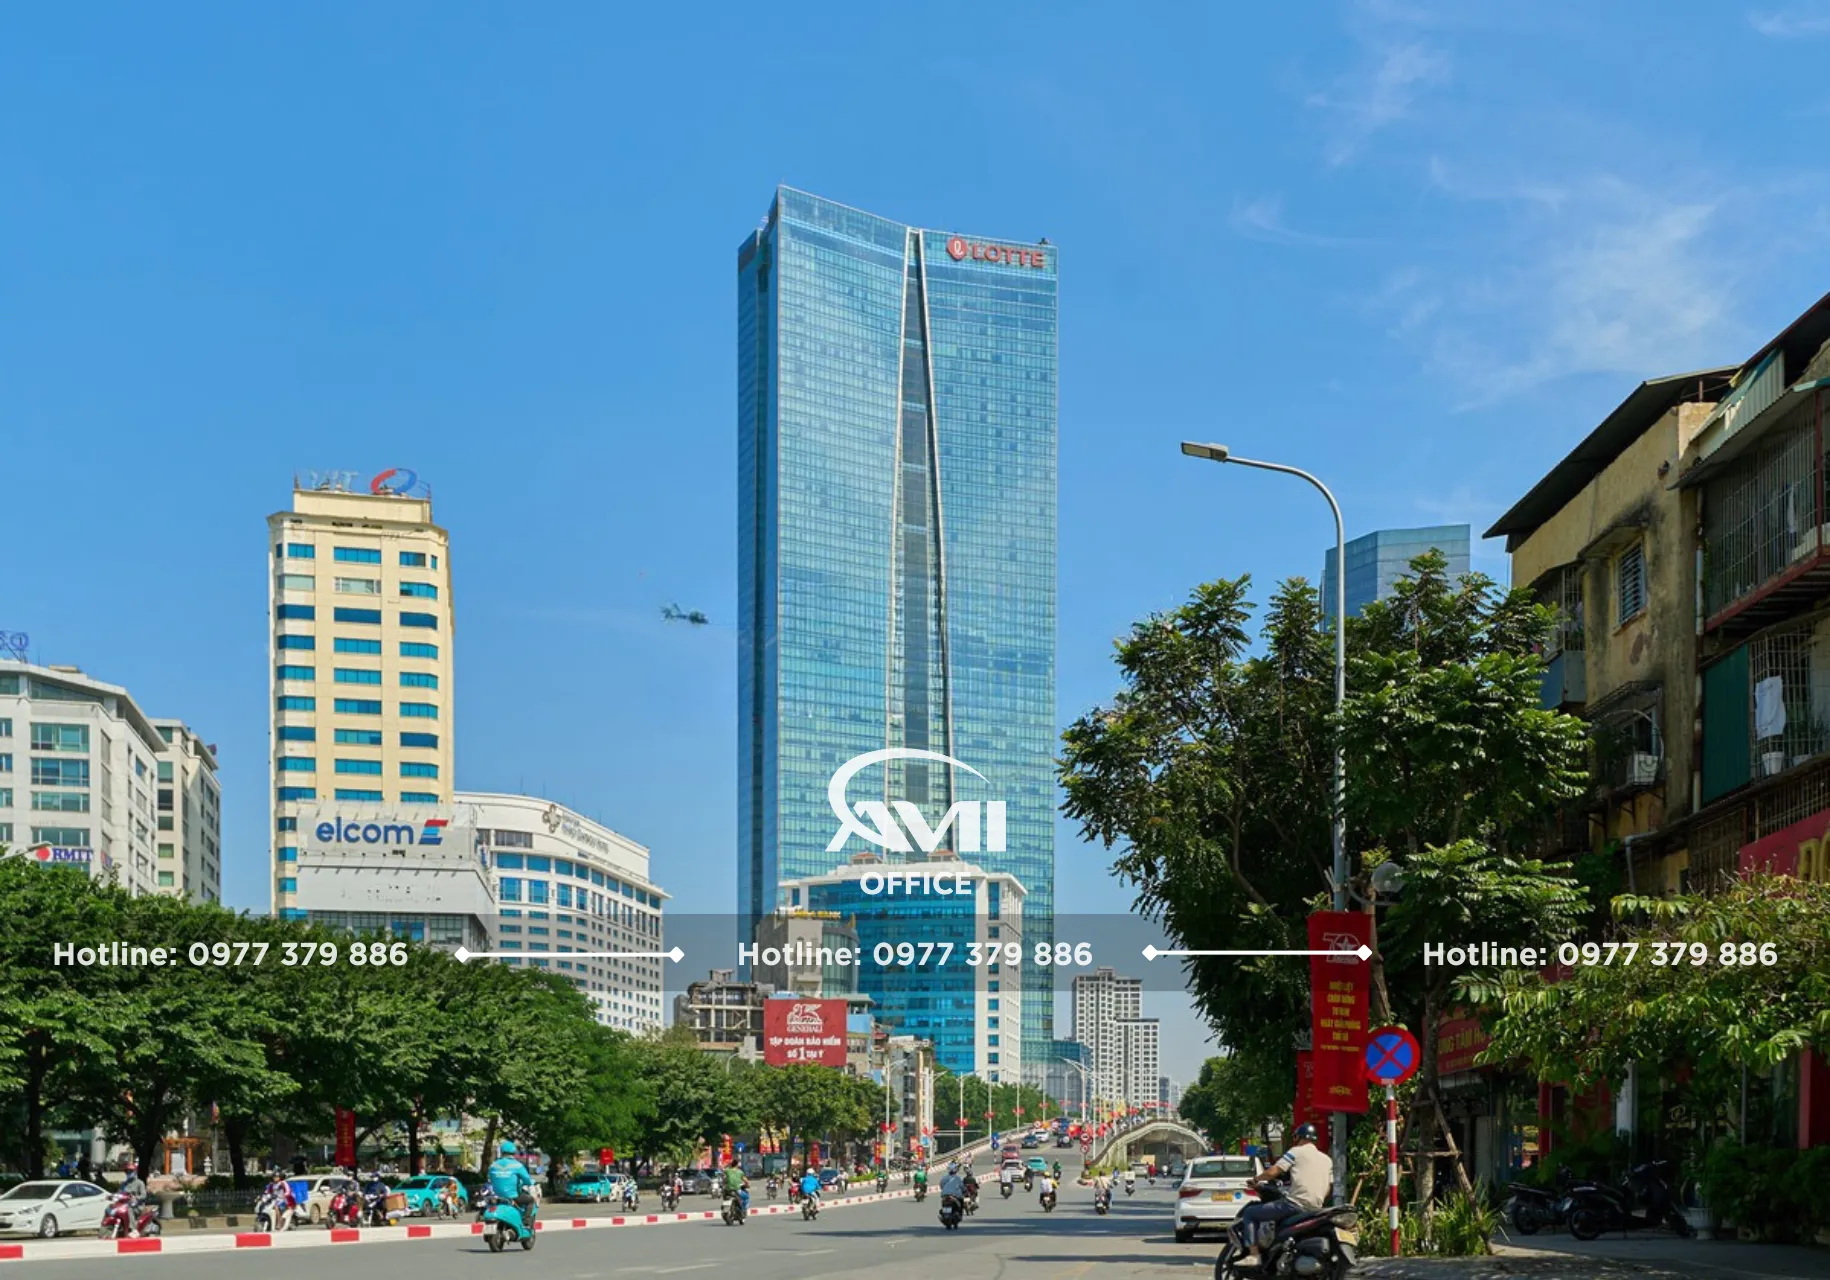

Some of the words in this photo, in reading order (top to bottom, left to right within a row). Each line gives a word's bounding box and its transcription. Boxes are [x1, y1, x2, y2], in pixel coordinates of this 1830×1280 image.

[972, 243, 1044, 268] LOTTE
[315, 816, 414, 845] elcom
[52, 847, 94, 861] RMIT
